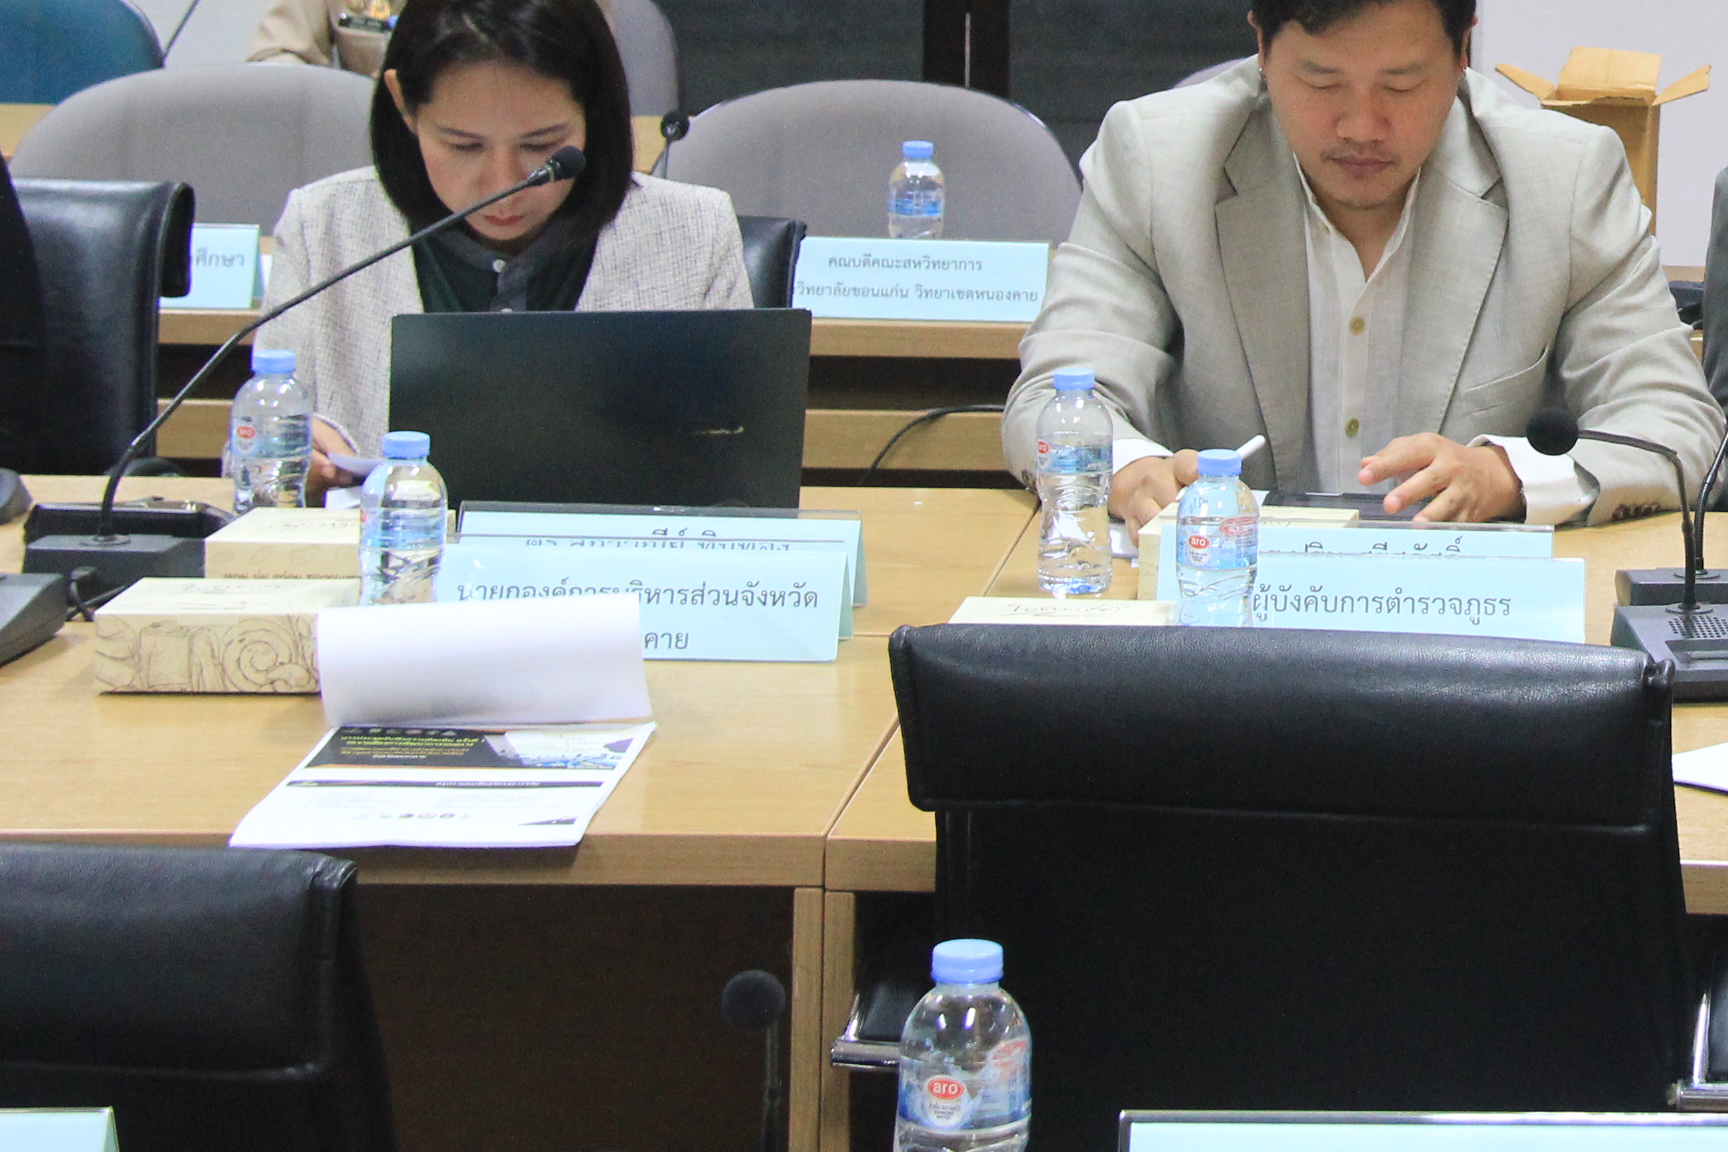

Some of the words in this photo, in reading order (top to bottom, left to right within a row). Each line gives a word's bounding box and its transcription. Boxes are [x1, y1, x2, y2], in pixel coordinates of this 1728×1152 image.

[195, 248, 245, 268] ศึกษา
[828, 253, 983, 272] คณบดีคณะสหวิทยาการ
[914, 283, 1039, 302] วิทยาเขตหนองคาย
[1190, 537, 1206, 546] aro
[1252, 582, 1512, 625] ผู้บังคับการตำรวจภูธร
[932, 1081, 959, 1095] aro
